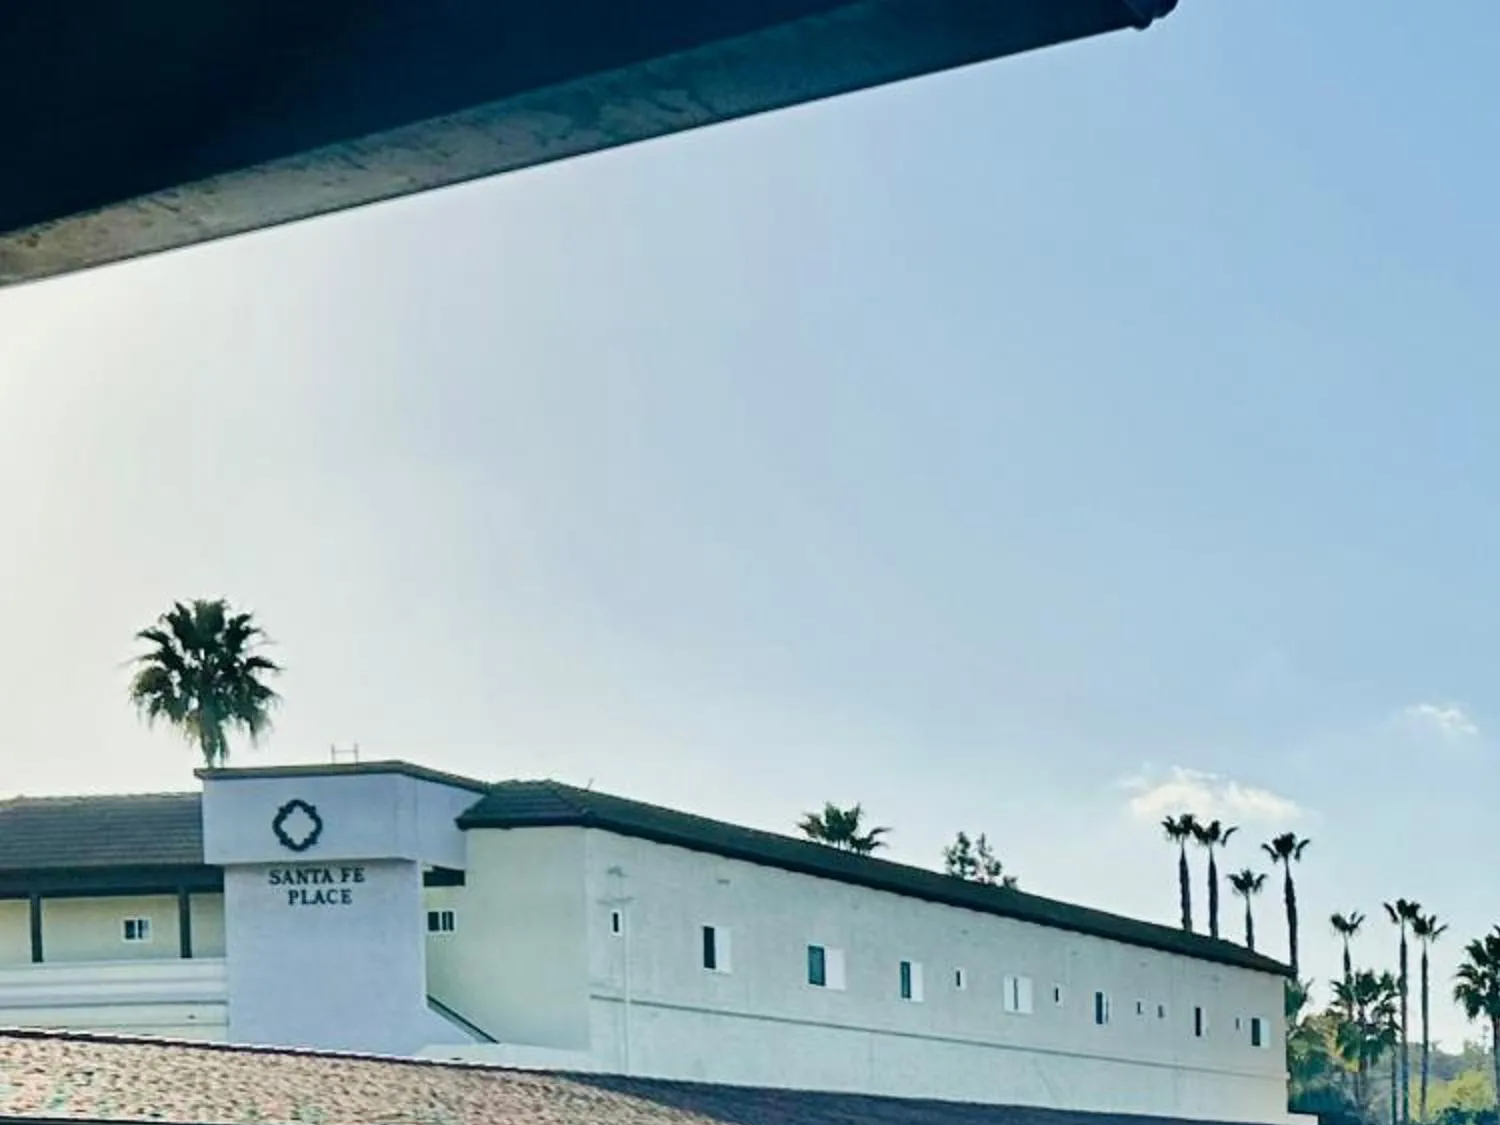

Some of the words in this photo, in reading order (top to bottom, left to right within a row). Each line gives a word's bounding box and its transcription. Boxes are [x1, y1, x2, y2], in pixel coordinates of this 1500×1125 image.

[268, 868, 333, 886] SANTA
[340, 867, 365, 883] FE
[288, 889, 352, 906] PLACE
